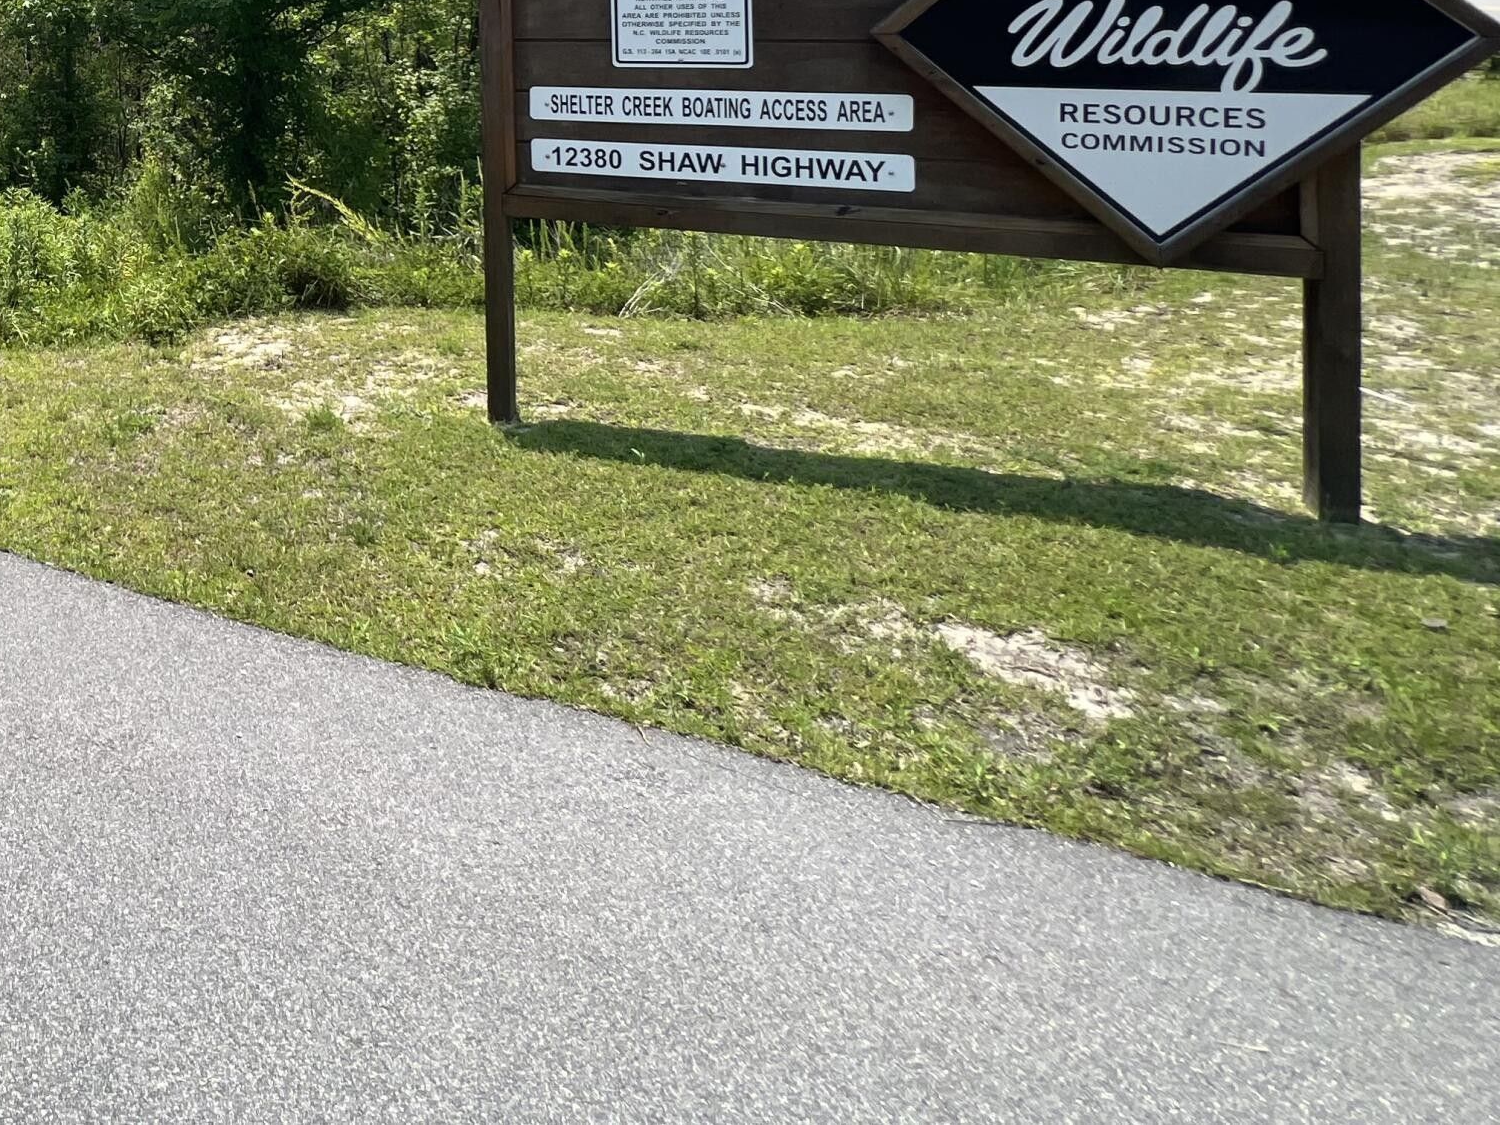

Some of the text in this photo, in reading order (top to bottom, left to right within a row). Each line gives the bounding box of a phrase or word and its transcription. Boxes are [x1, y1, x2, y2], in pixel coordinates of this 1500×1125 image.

[550, 94, 885, 123] SHELTER CREEK BOATING ACCESS AREA
[1059, 102, 1266, 129] RESOURCES
[1062, 133, 1266, 157] COMMISSION
[551, 147, 885, 182] 12380 SHAW HIGHWAY
